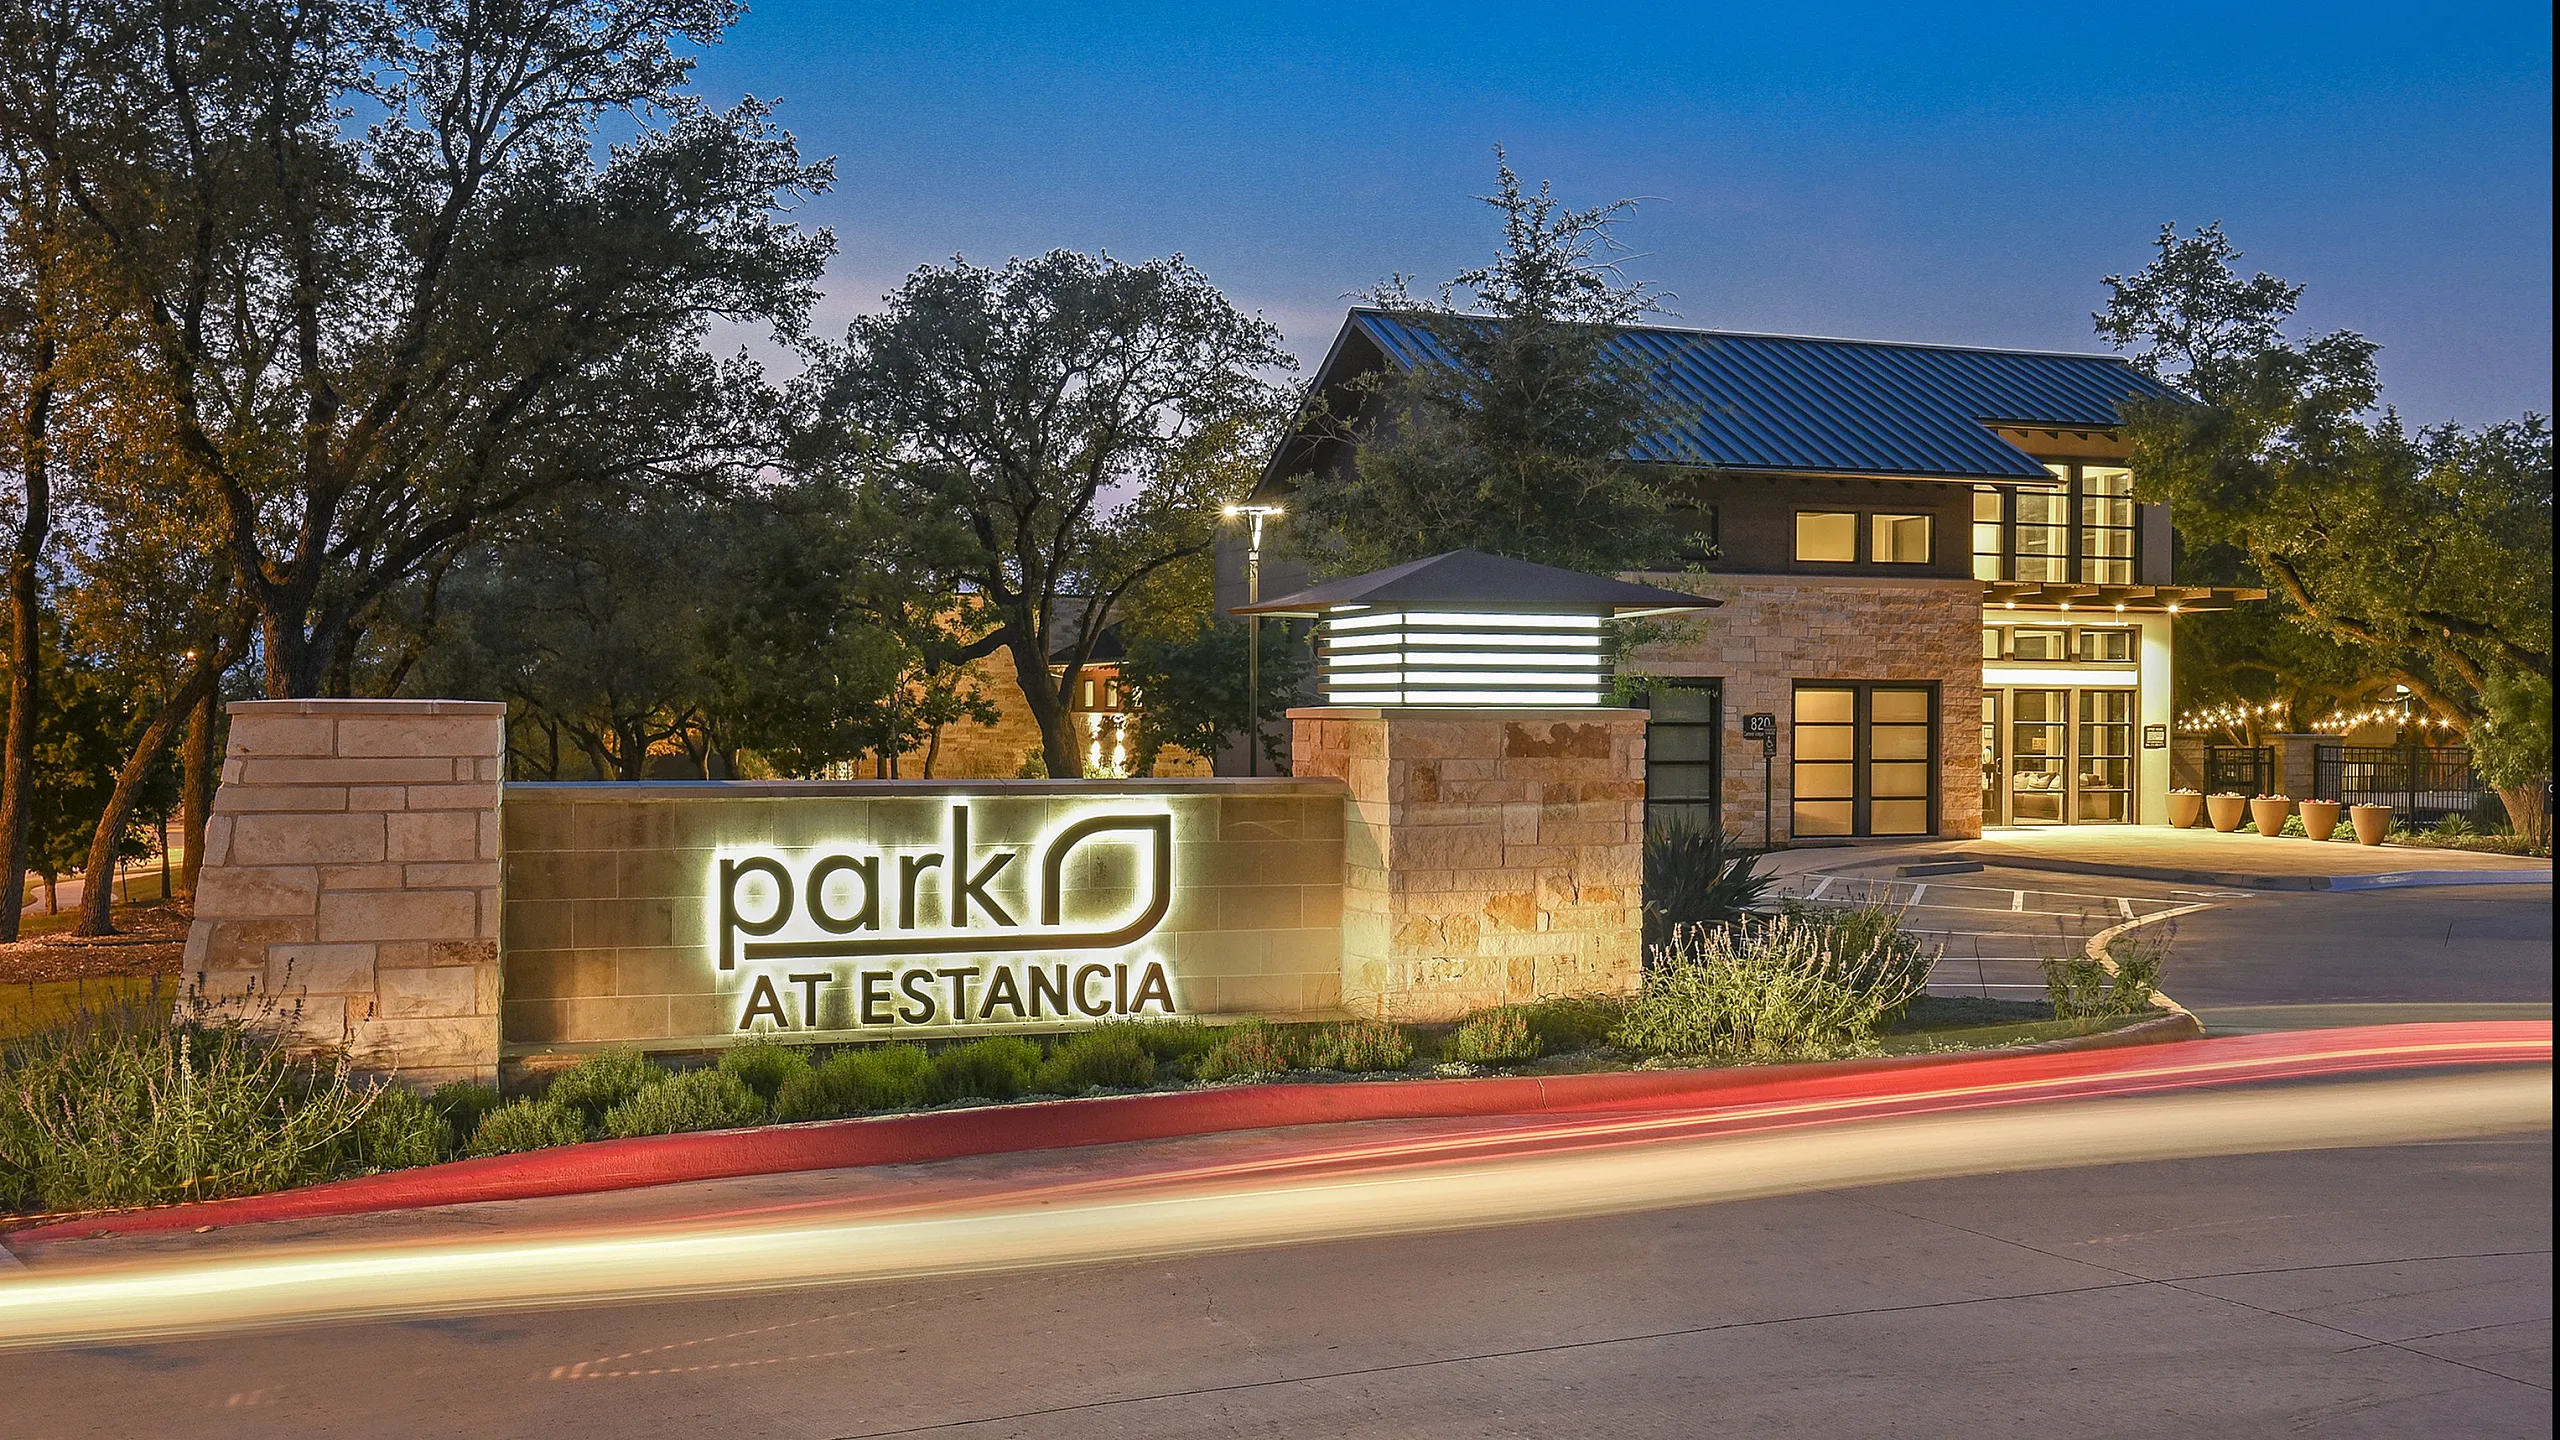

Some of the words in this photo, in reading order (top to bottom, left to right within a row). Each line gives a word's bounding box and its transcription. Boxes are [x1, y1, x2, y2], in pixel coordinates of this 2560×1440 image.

[1751, 717, 1770, 730] 820
[719, 805, 1017, 970] park
[739, 972, 832, 1029] AT
[860, 961, 1176, 1025] ESTANCIA
